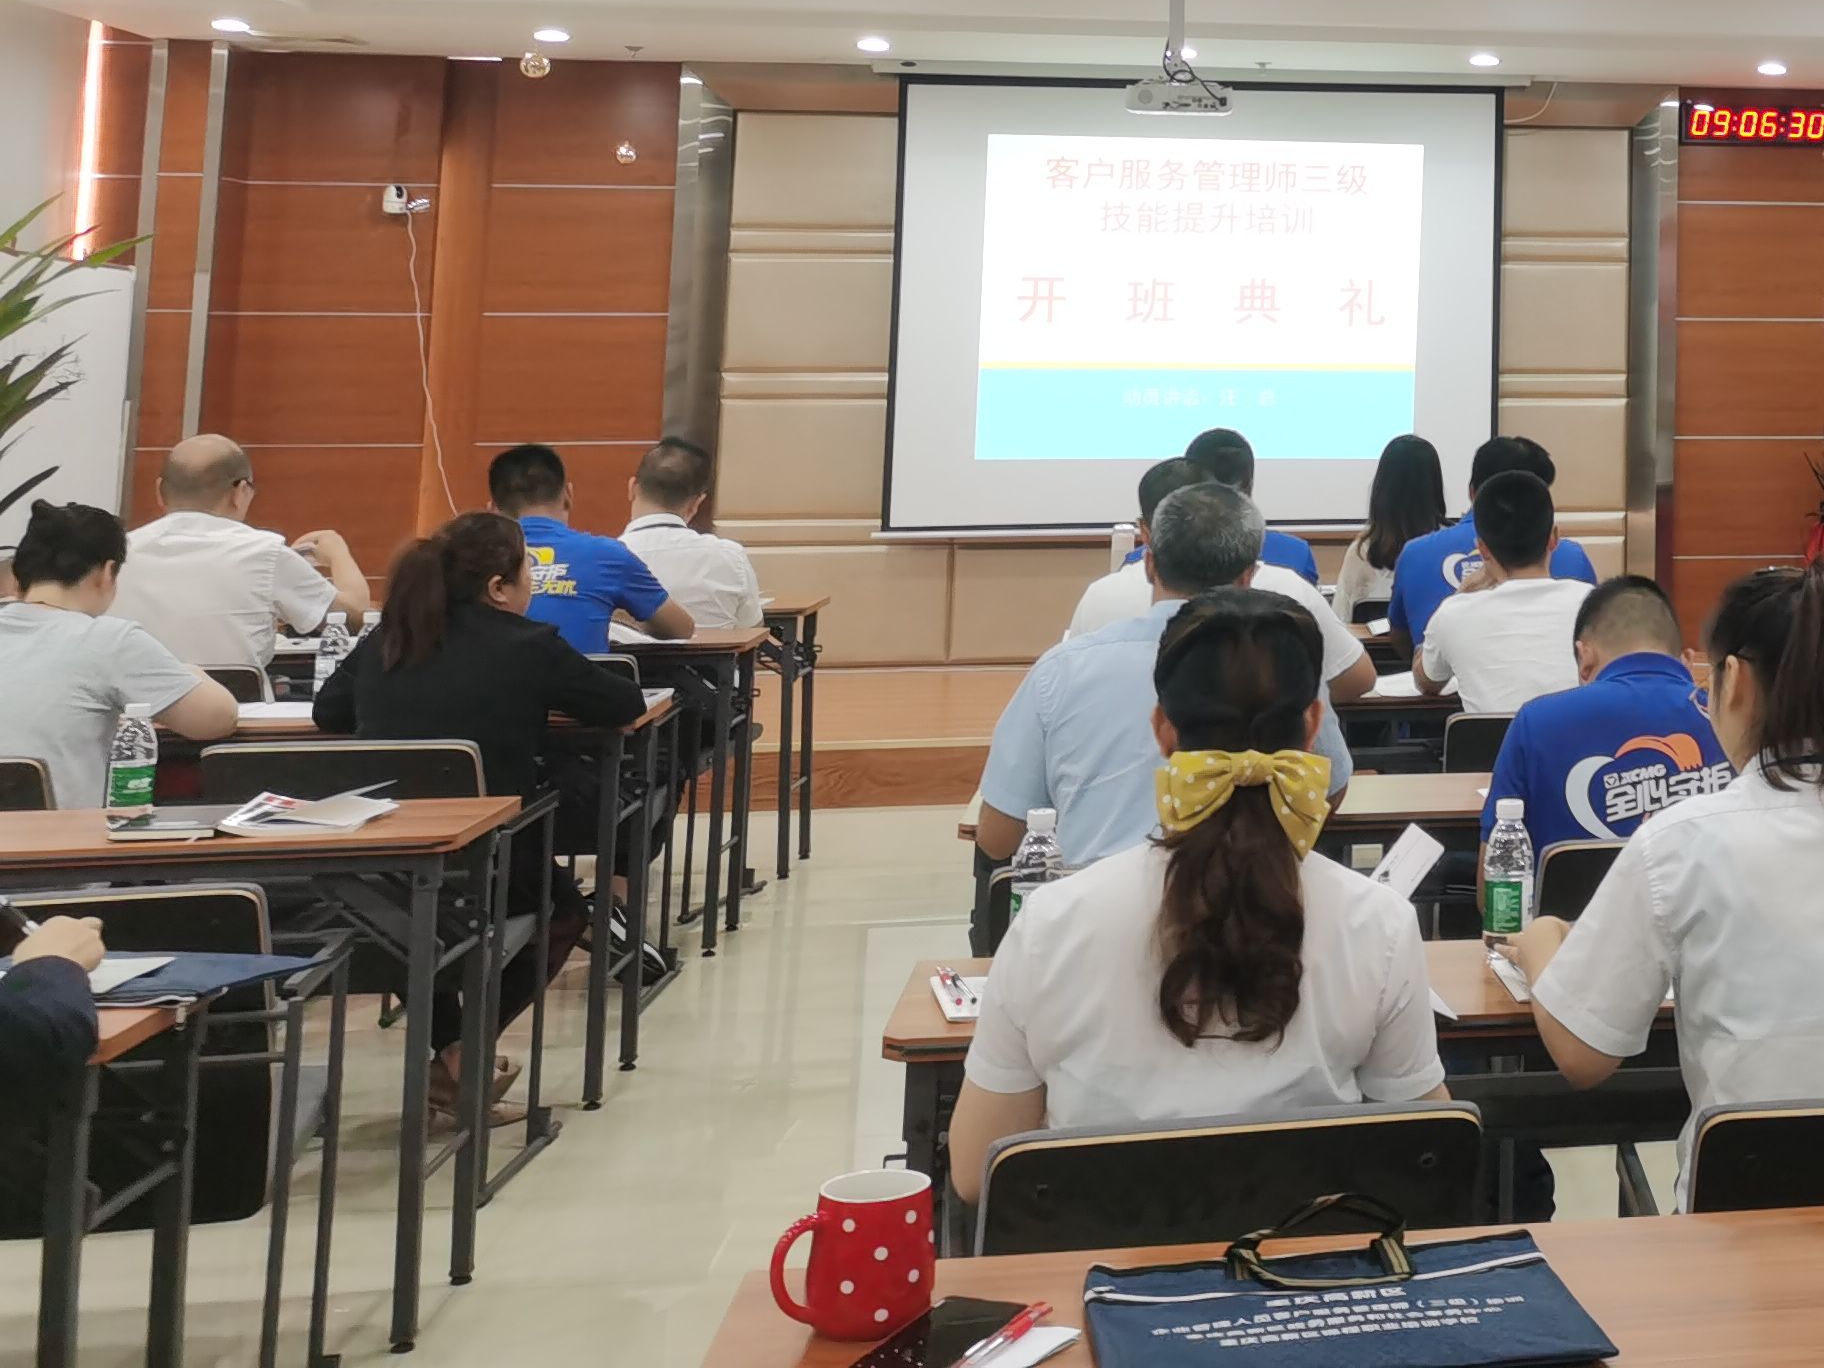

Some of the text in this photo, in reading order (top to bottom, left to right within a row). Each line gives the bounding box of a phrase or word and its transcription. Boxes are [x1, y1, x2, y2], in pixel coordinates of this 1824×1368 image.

[1045, 156, 1369, 195] 客户服务管理师三级
[1099, 201, 1314, 234] 技能提升培训
[1620, 763, 1667, 785] XCMG
